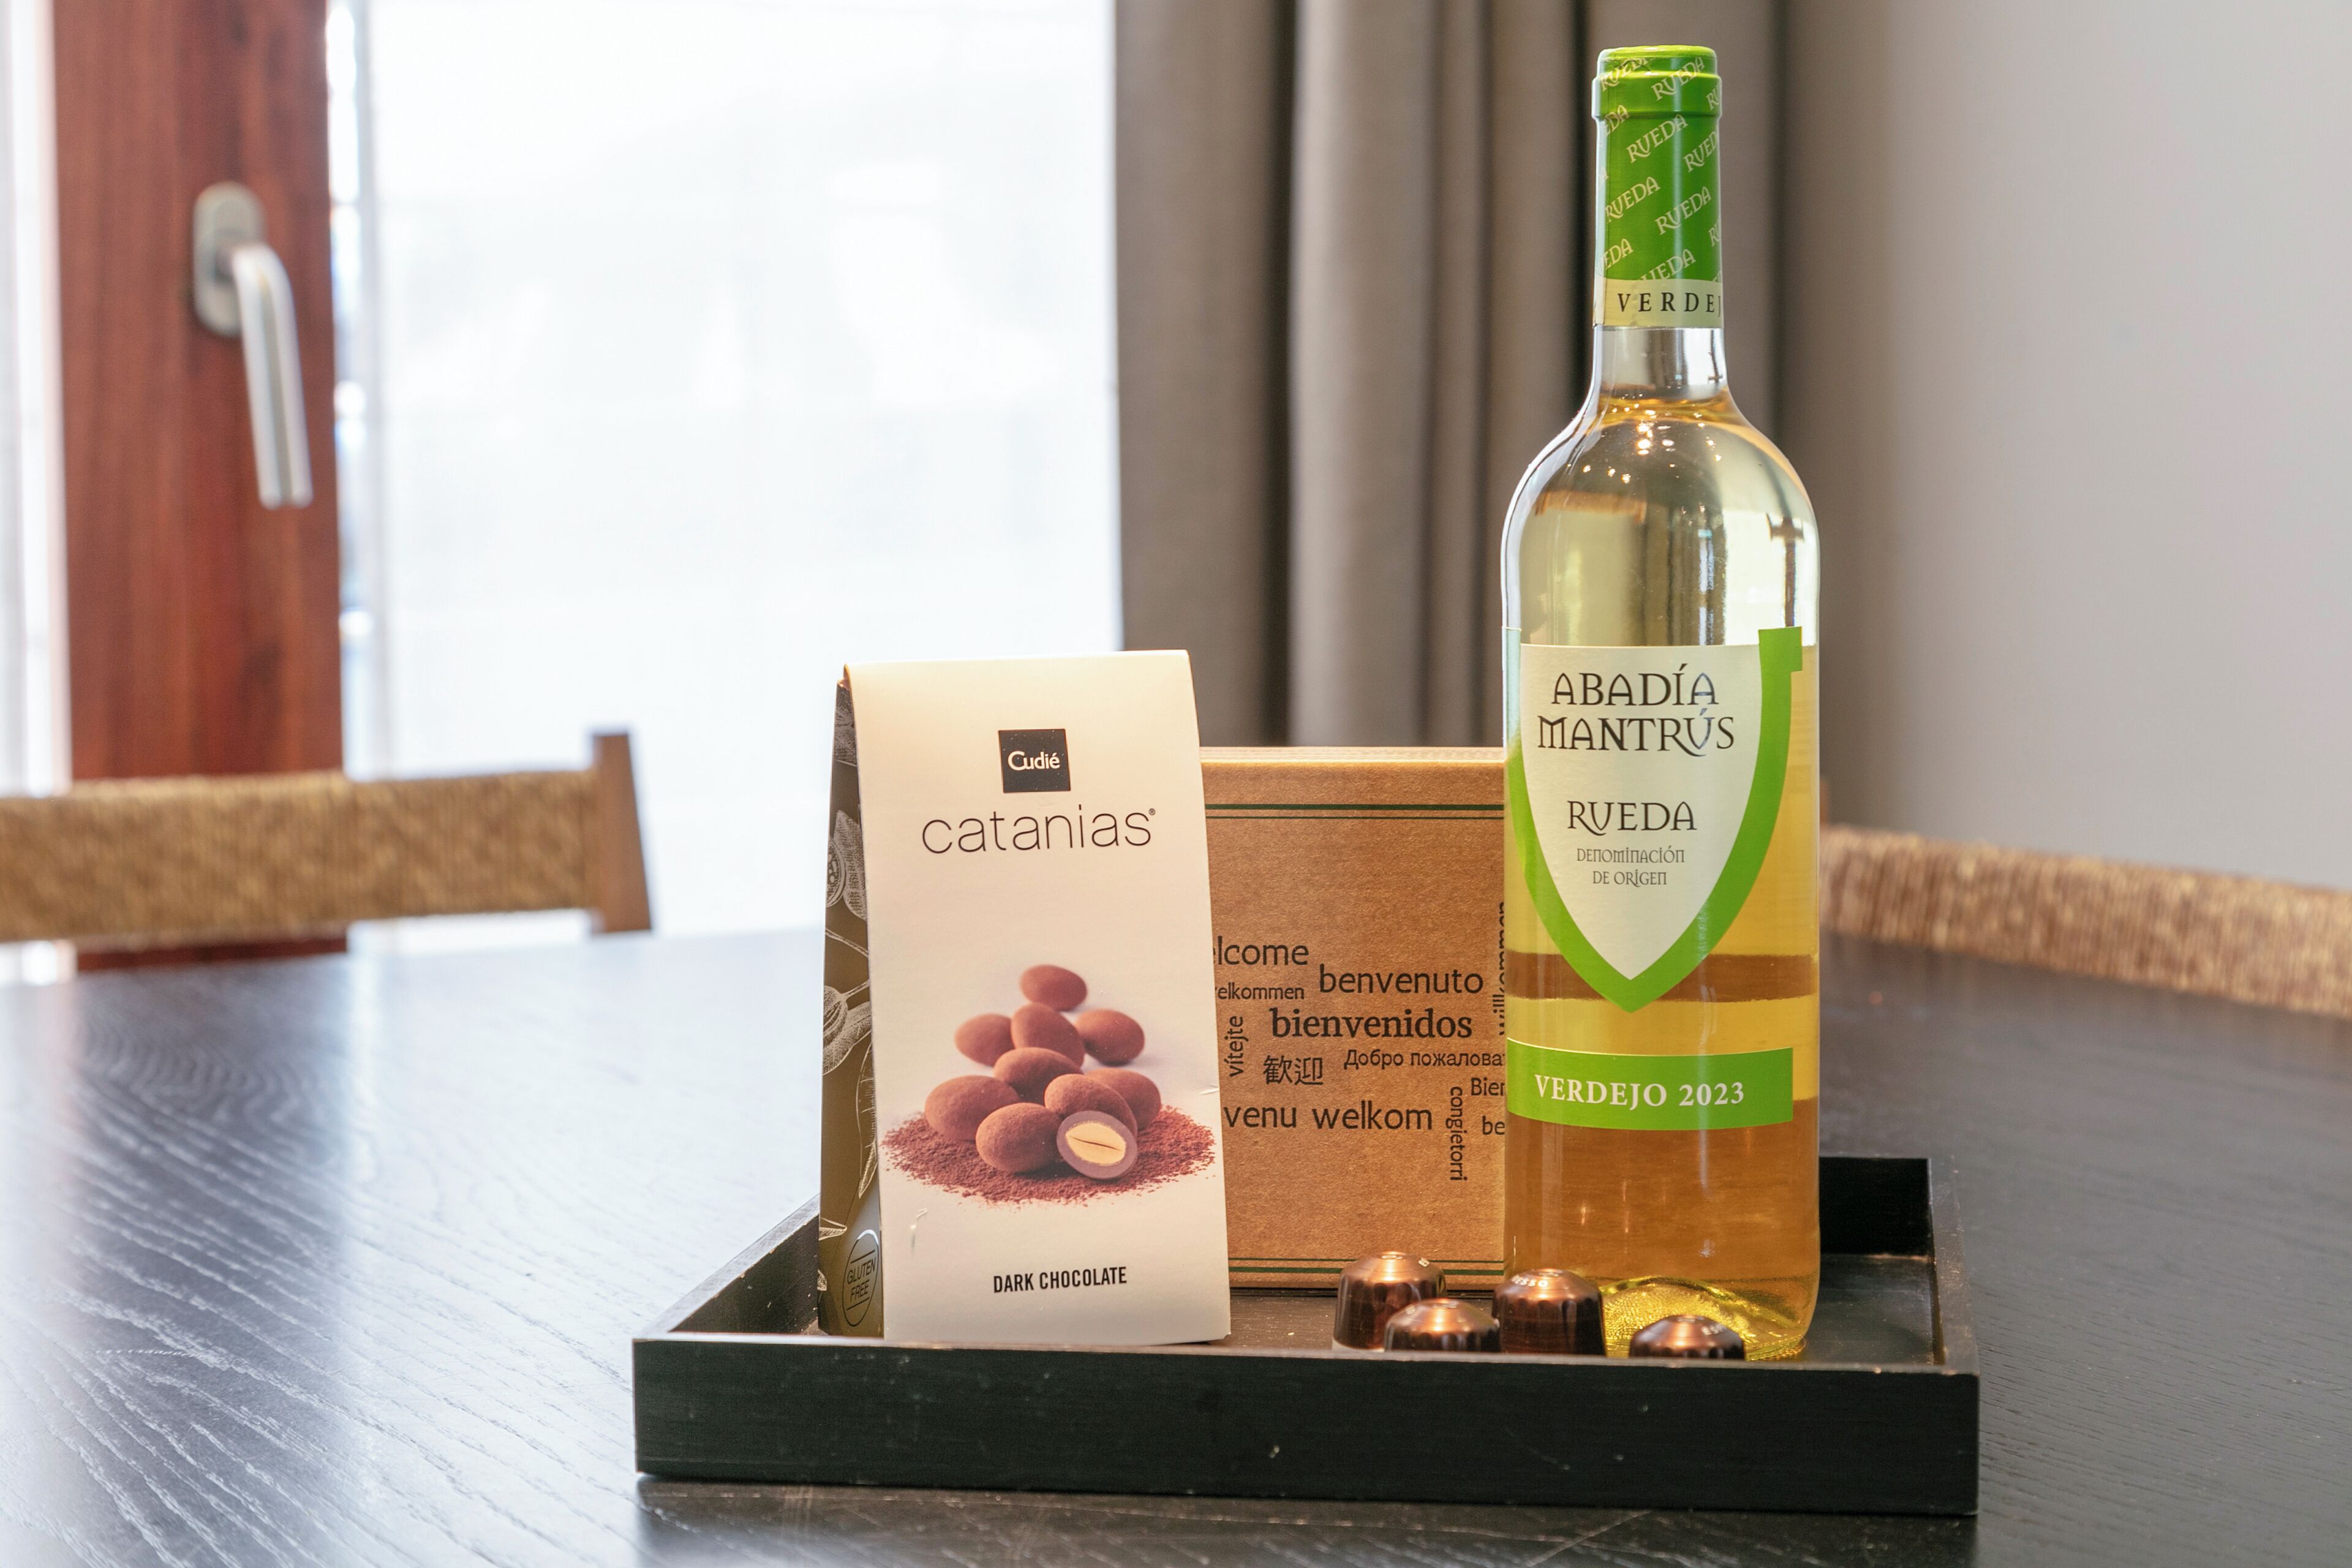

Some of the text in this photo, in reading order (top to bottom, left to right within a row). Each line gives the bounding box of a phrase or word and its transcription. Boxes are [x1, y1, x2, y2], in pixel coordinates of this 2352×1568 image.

[1651, 57, 1705, 100] RUEDA
[1627, 115, 1688, 163] RUEDA
[1604, 176, 1660, 223] RUEDA
[1655, 186, 1711, 235] RUEDA
[1551, 663, 1719, 706] ABADÍA
[1537, 708, 1734, 756] MANTRÚS
[1007, 750, 1060, 771] Cudié
[1567, 801, 1697, 835] RUEDA
[1593, 872, 1610, 885] DE
[1213, 935, 1309, 965] lcome
[1215, 982, 1305, 1000] elkommen
[1319, 964, 1483, 994] benvenuto
[1270, 1007, 1472, 1039] bienvenidos
[1224, 1016, 1249, 1077] vítejte
[1344, 1049, 1505, 1070] Добро пожалова
[1263, 1055, 1324, 1085] 歓迎
[1535, 1074, 1744, 1110] VERDEJO 2023
[1224, 1101, 1433, 1130] venu welkom
[1440, 1086, 1468, 1181] congietorri
[846, 1257, 876, 1284] GLUTEN
[993, 1266, 1128, 1294] DARK CHOCOLATE
[850, 1279, 870, 1303] FREE
